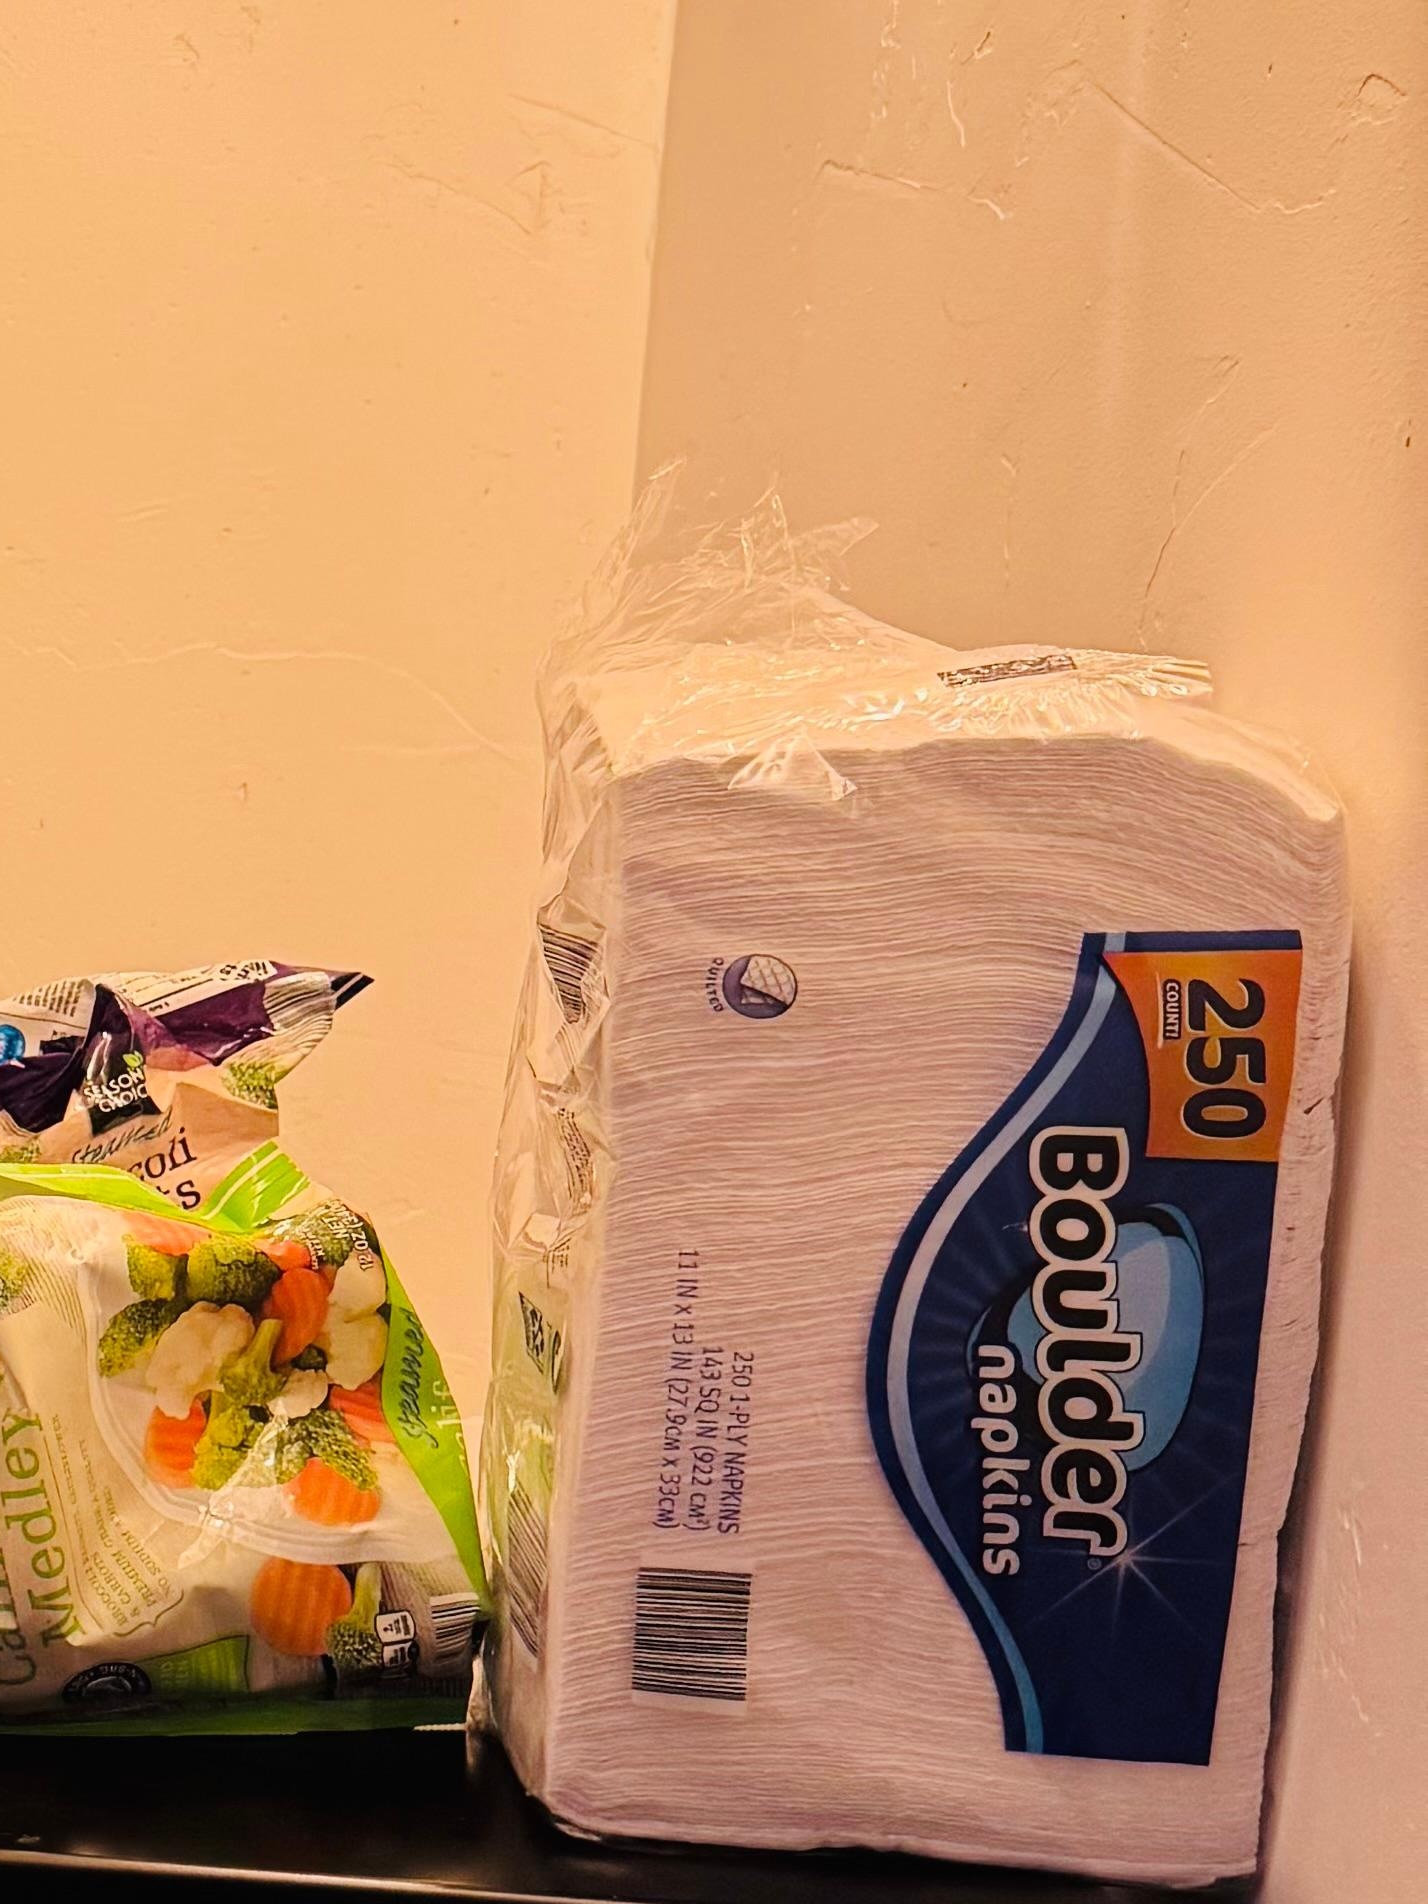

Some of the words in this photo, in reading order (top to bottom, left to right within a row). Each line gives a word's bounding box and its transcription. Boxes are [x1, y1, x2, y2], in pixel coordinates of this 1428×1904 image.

[705, 957, 724, 1012] QUILTED
[1162, 977, 1182, 1041] COUNT!
[1182, 976, 1267, 1140] 250
[351, 1230, 368, 1251] OZ
[677, 1250, 700, 1270] 11
[677, 1279, 699, 1298] IN
[671, 1323, 694, 1345] 13
[1029, 1126, 1145, 1557] Boulder
[670, 1352, 693, 1370] IN
[699, 1346, 724, 1381] 143
[732, 1351, 754, 1388] 250
[694, 1386, 721, 1414] SQ
[695, 1420, 718, 1439] IN
[725, 1394, 751, 1448] 1-PLY
[690, 1446, 717, 1487] (922
[971, 1345, 1032, 1576] napkins
[652, 1473, 681, 1529] 33CM)
[717, 1451, 746, 1535] NAPKINS
[1, 1407, 88, 1649] Medley
